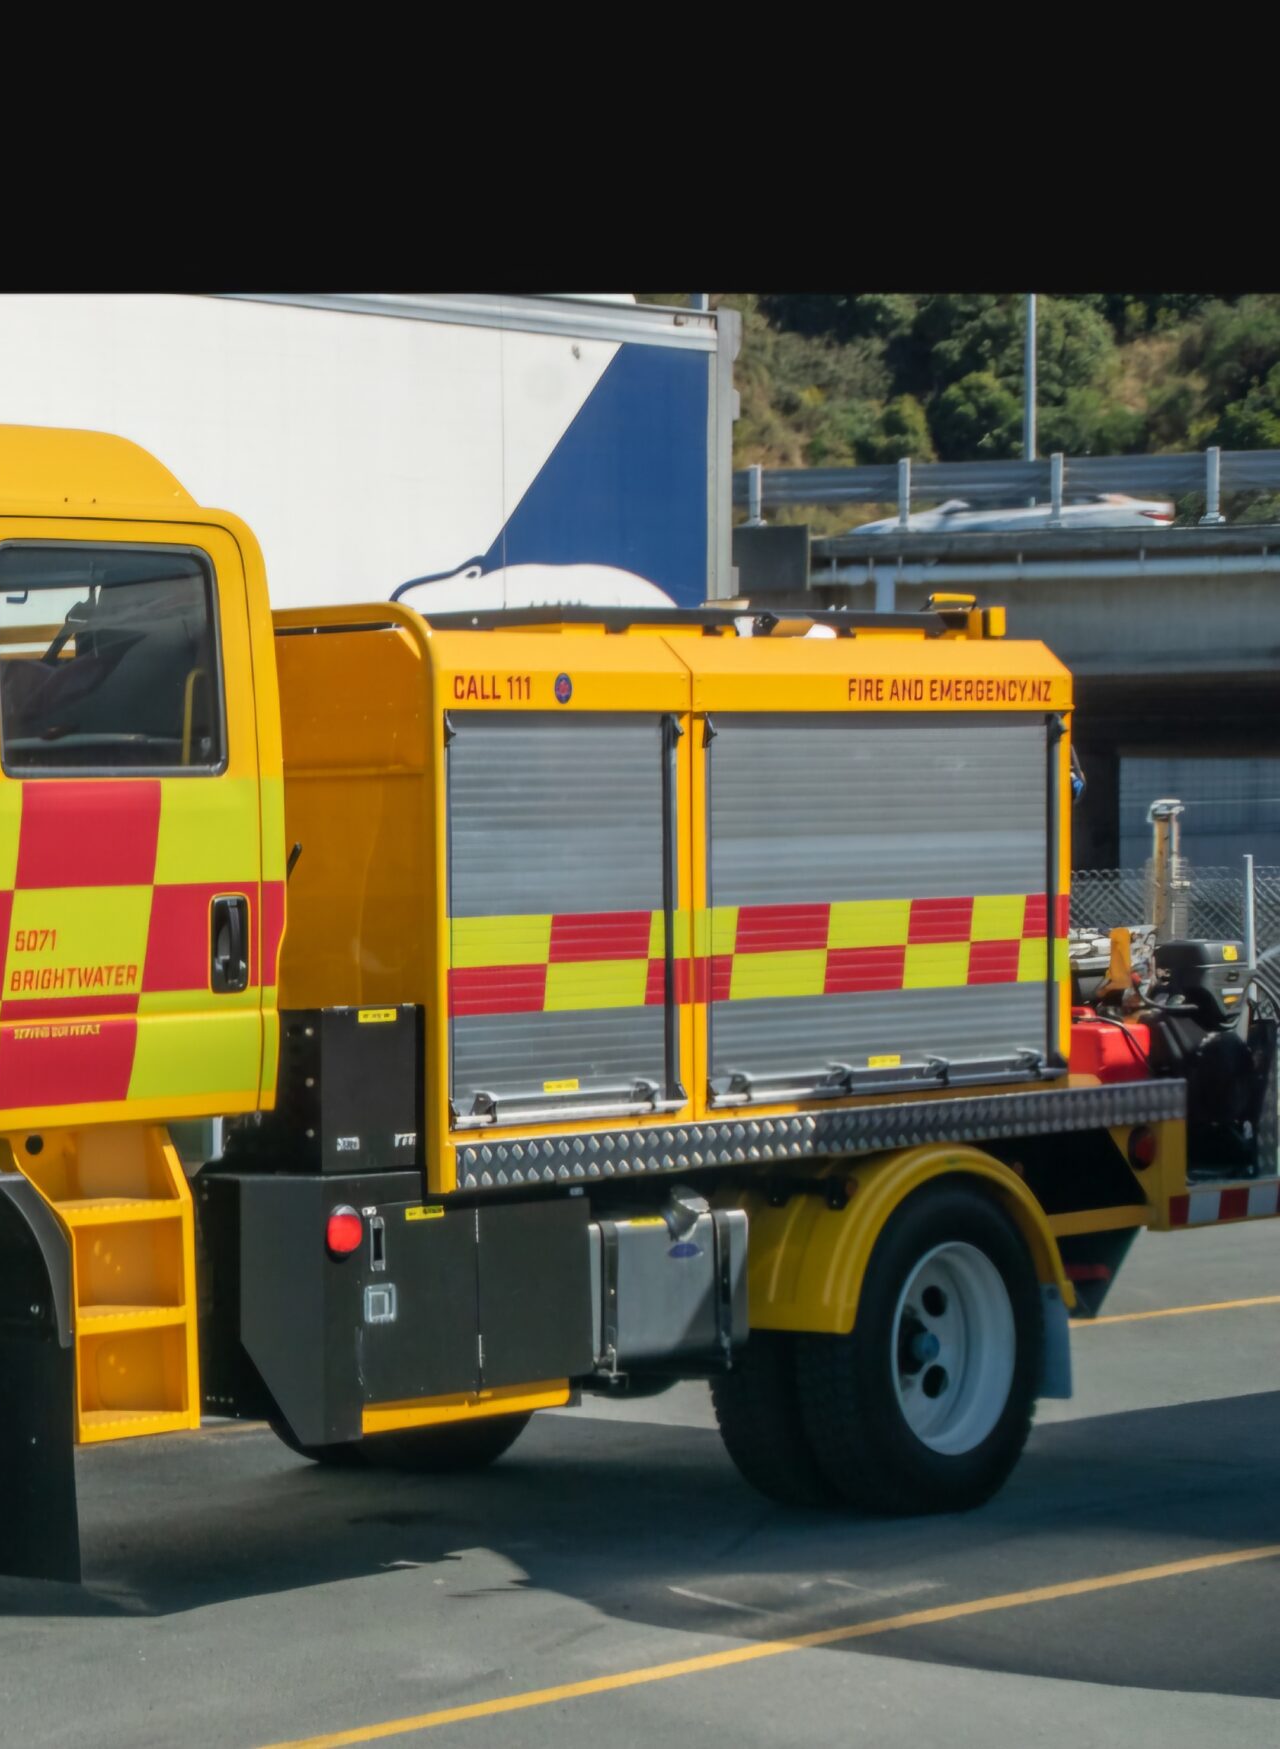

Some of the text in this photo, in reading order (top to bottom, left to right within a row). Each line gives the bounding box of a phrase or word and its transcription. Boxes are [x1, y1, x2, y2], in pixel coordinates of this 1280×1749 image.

[453, 674, 531, 700] CALL 111
[848, 678, 1052, 702] FIRE AND EMERGENCY.NZ
[10, 964, 138, 992] BRIGHTWATER
